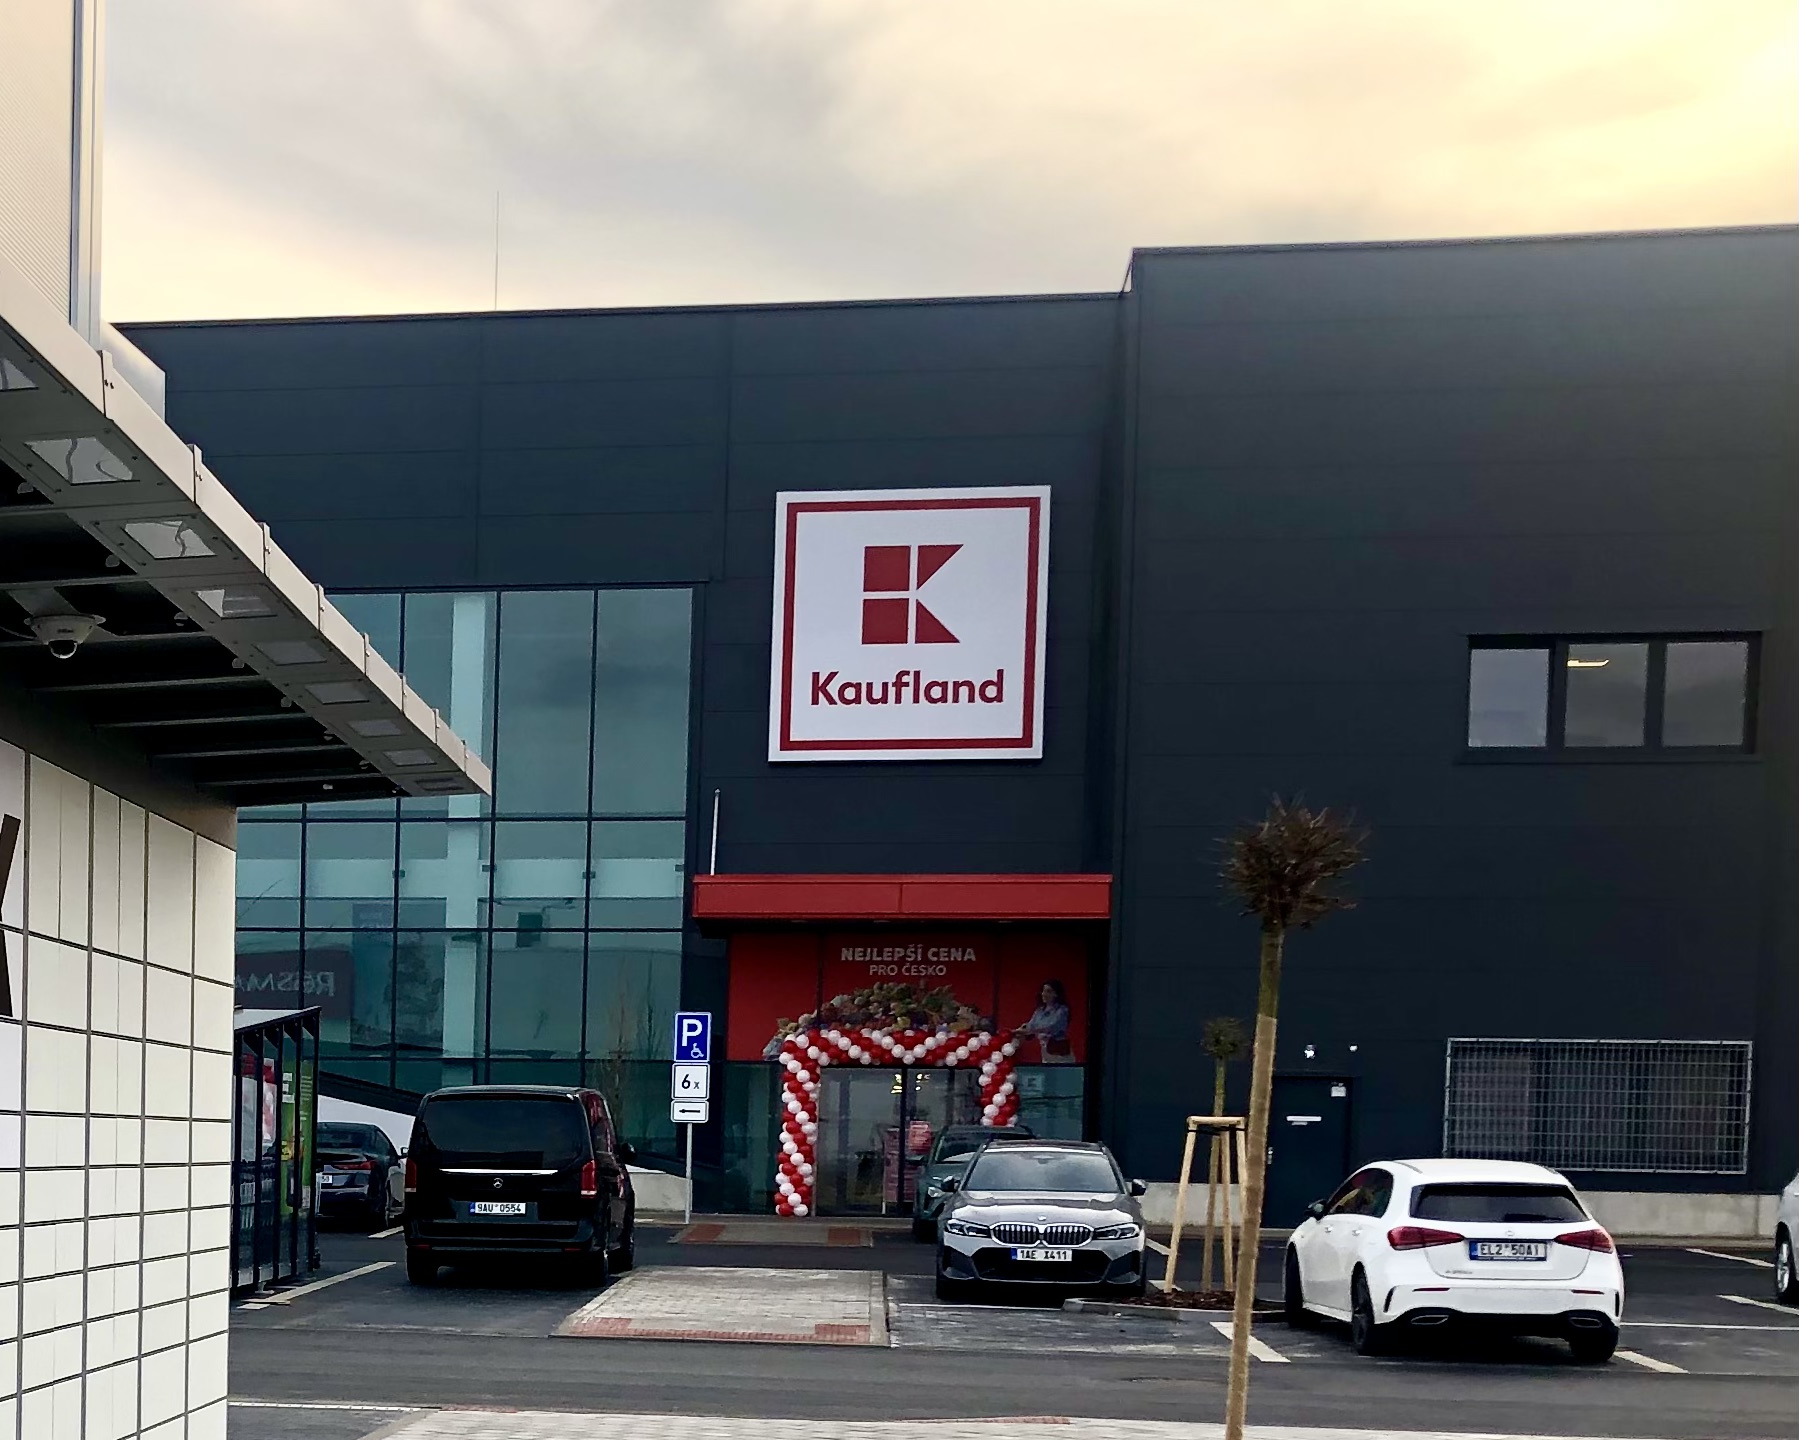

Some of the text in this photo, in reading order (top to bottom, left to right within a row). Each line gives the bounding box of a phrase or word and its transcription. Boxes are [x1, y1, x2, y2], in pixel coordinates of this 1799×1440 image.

[810, 668, 1005, 706] Kaufland
[840, 943, 977, 962] NEJLEPŠÍ CENA
[868, 962, 947, 976] PRO ČESKO
[681, 1018, 703, 1047] P
